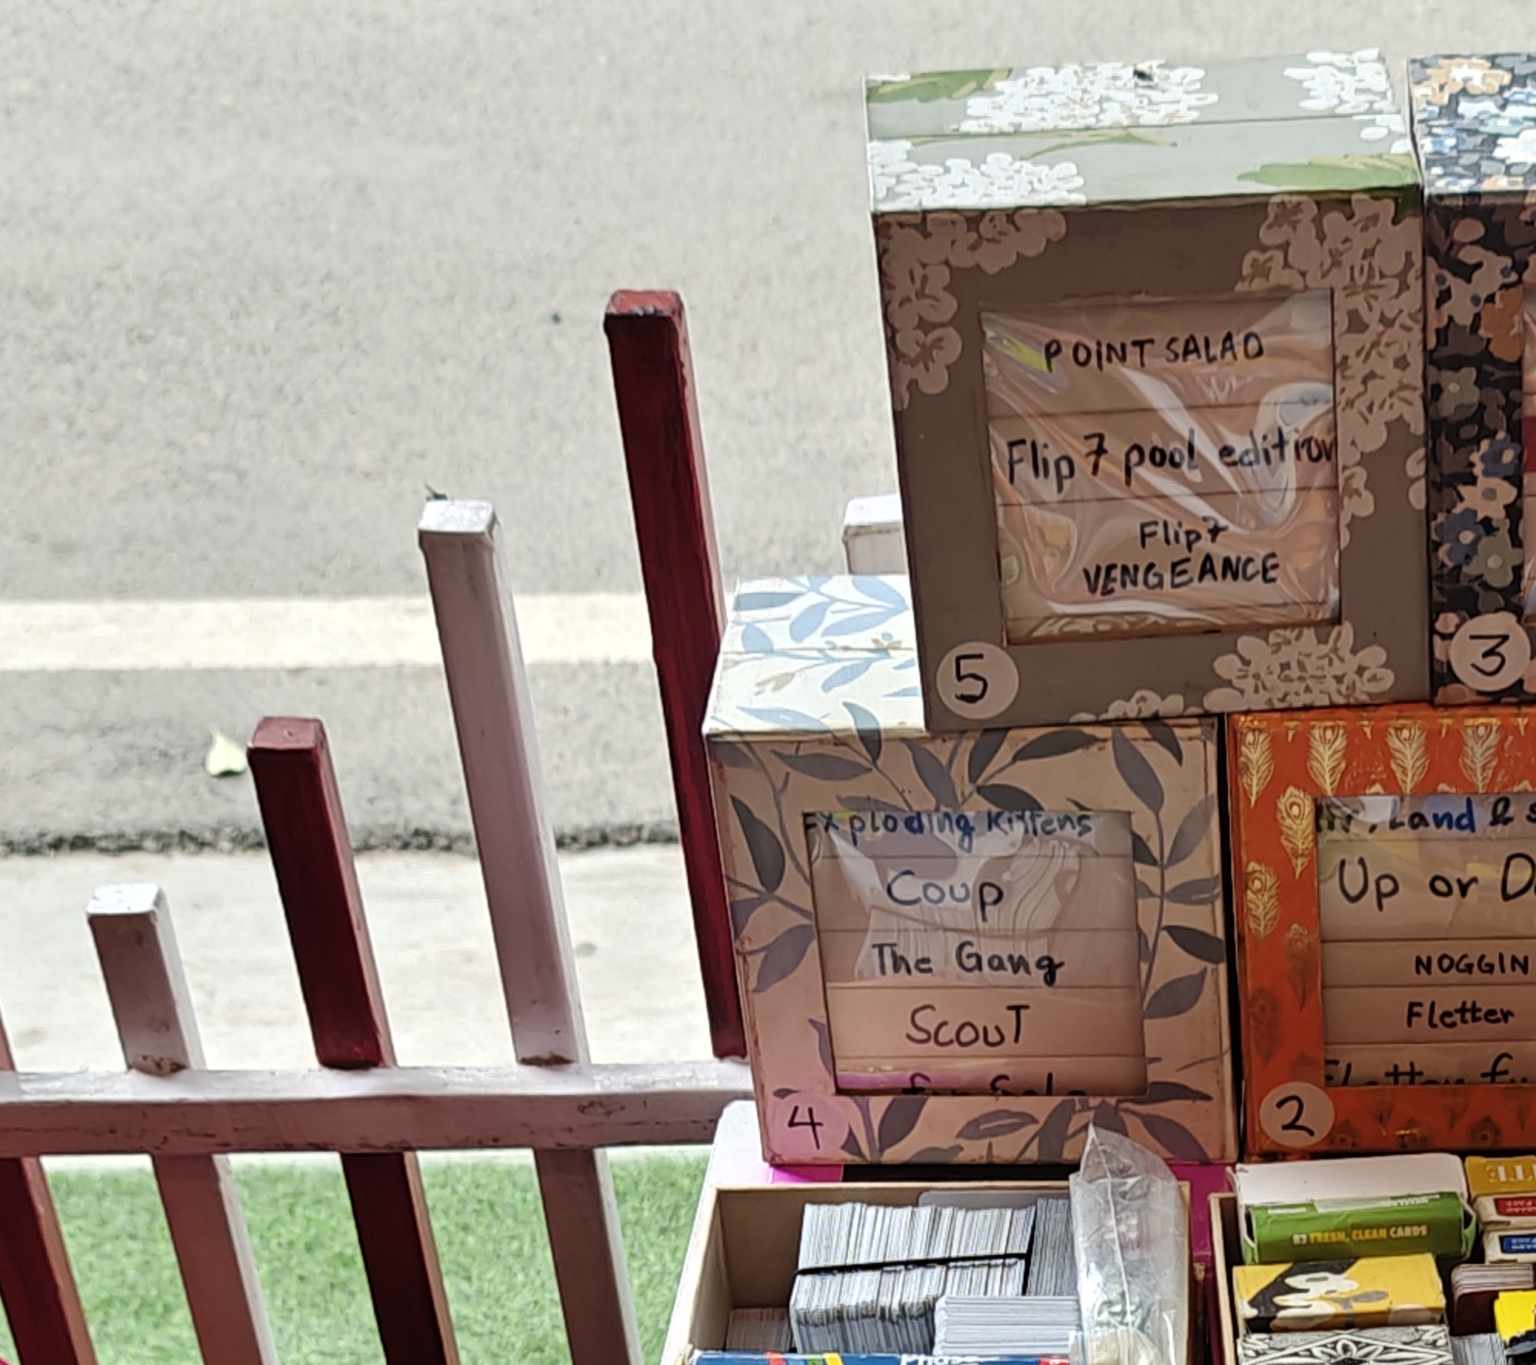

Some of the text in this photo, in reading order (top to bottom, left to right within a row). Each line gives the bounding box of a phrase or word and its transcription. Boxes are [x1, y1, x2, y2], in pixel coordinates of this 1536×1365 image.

[1045, 331, 1264, 373] POINT SALAD
[1006, 440, 1075, 494] Flip
[1124, 427, 1201, 487] pool
[1083, 551, 1280, 597] VENGEANCE
[1468, 634, 1510, 678] 3
[954, 653, 990, 705] 5
[1387, 796, 1477, 833] Land
[1489, 796, 1515, 827] &
[887, 869, 1004, 923] Coup
[1337, 855, 1400, 913] Up
[1428, 872, 1480, 900] or
[870, 940, 1065, 987] The Gang
[1413, 952, 1531, 977] NOGGIN
[1405, 1000, 1516, 1030] Fletter
[786, 1105, 824, 1150] 4
[1275, 1094, 1315, 1138] 2
[1389, 1225, 1428, 1239] CARDS
